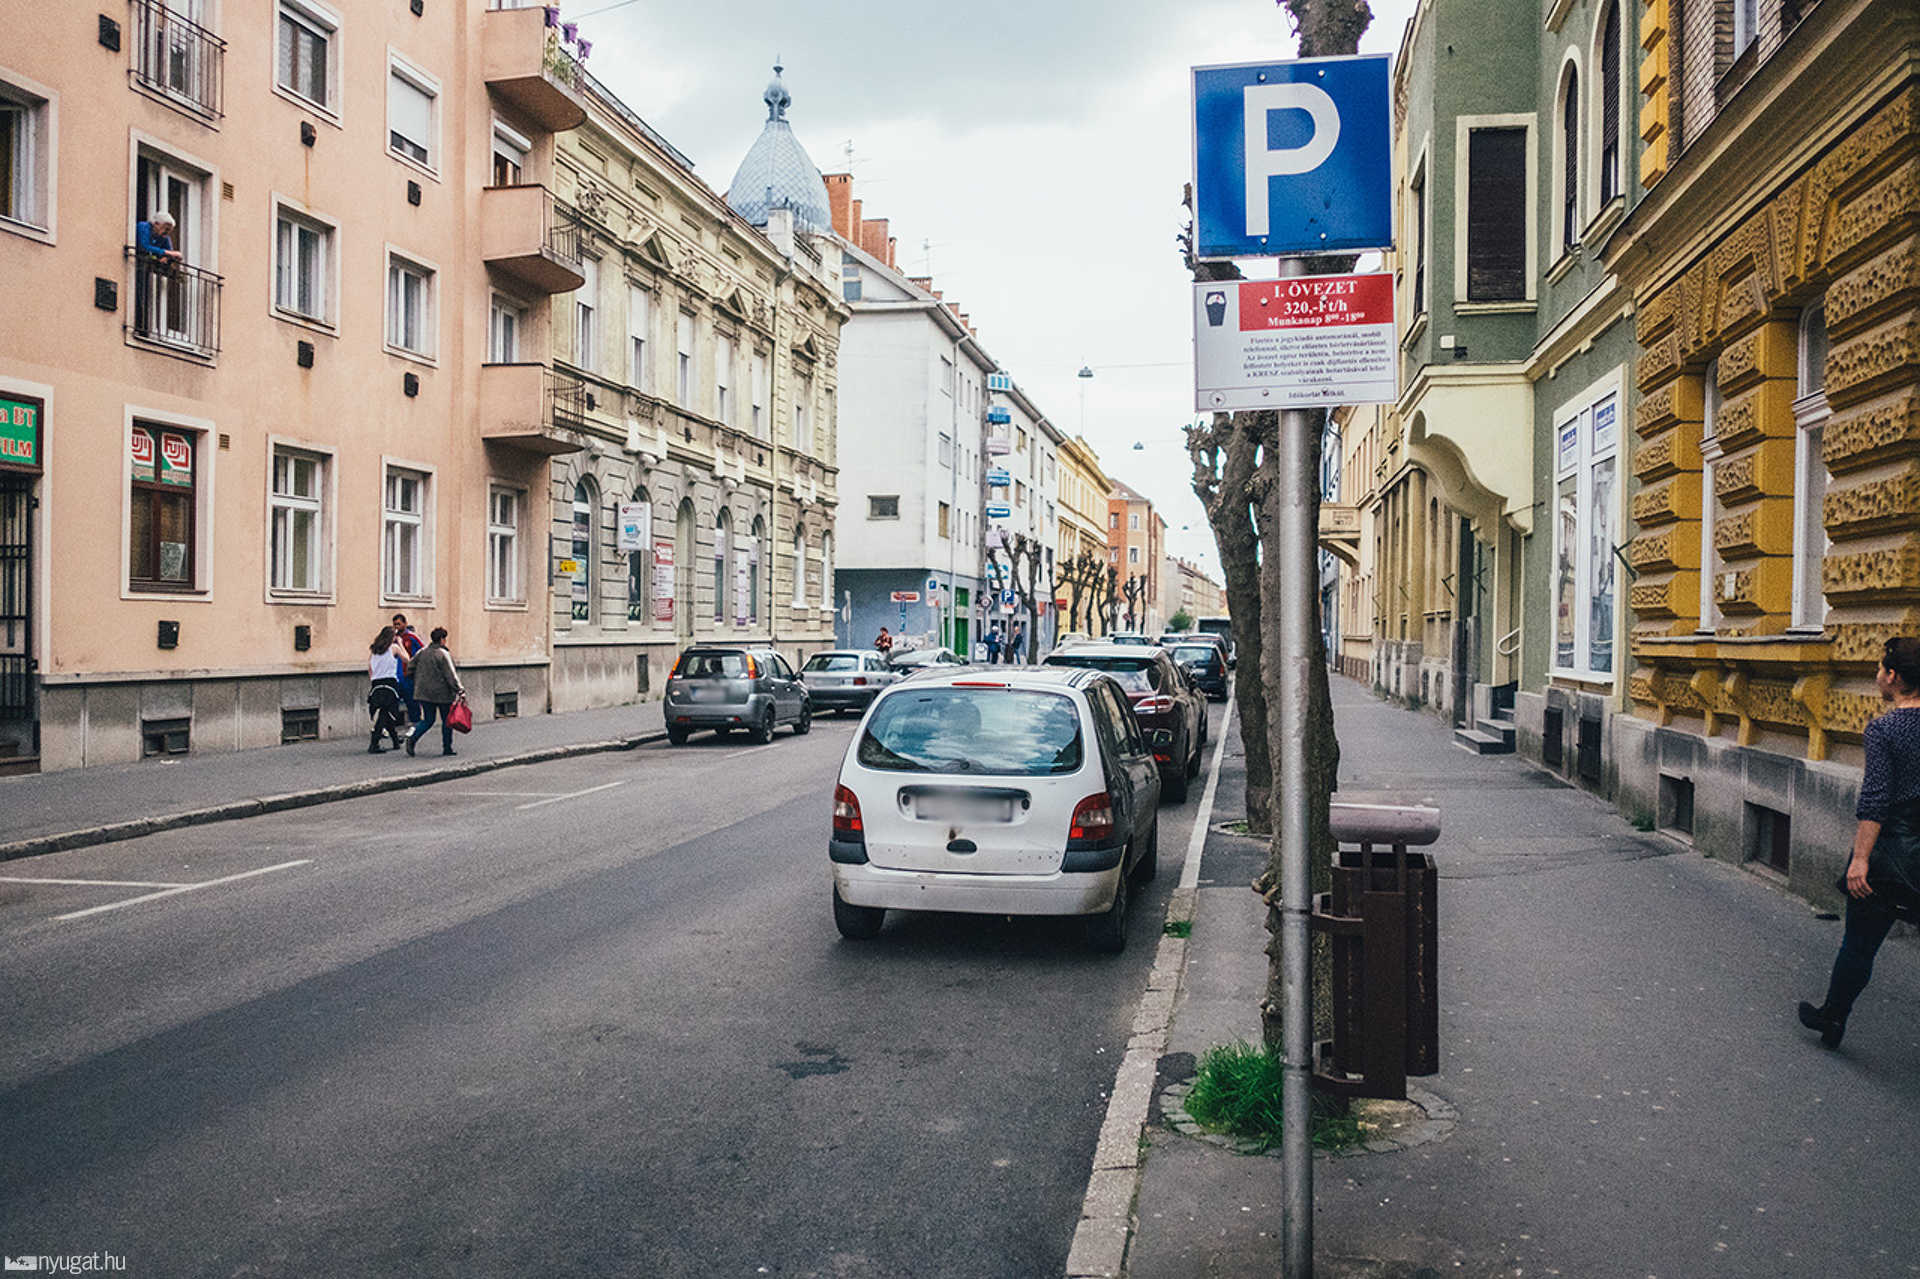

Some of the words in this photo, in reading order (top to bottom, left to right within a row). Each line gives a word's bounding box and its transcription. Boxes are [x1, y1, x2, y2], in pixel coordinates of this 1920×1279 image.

[1244, 82, 1341, 237] P
[1274, 285, 1284, 298] I.
[1288, 280, 1358, 297] ÖVEZET
[1268, 314, 1322, 326] Munkanap
[14, 406, 35, 428] BT
[0, 437, 32, 458] ILM
[163, 433, 186, 460] FUJI
